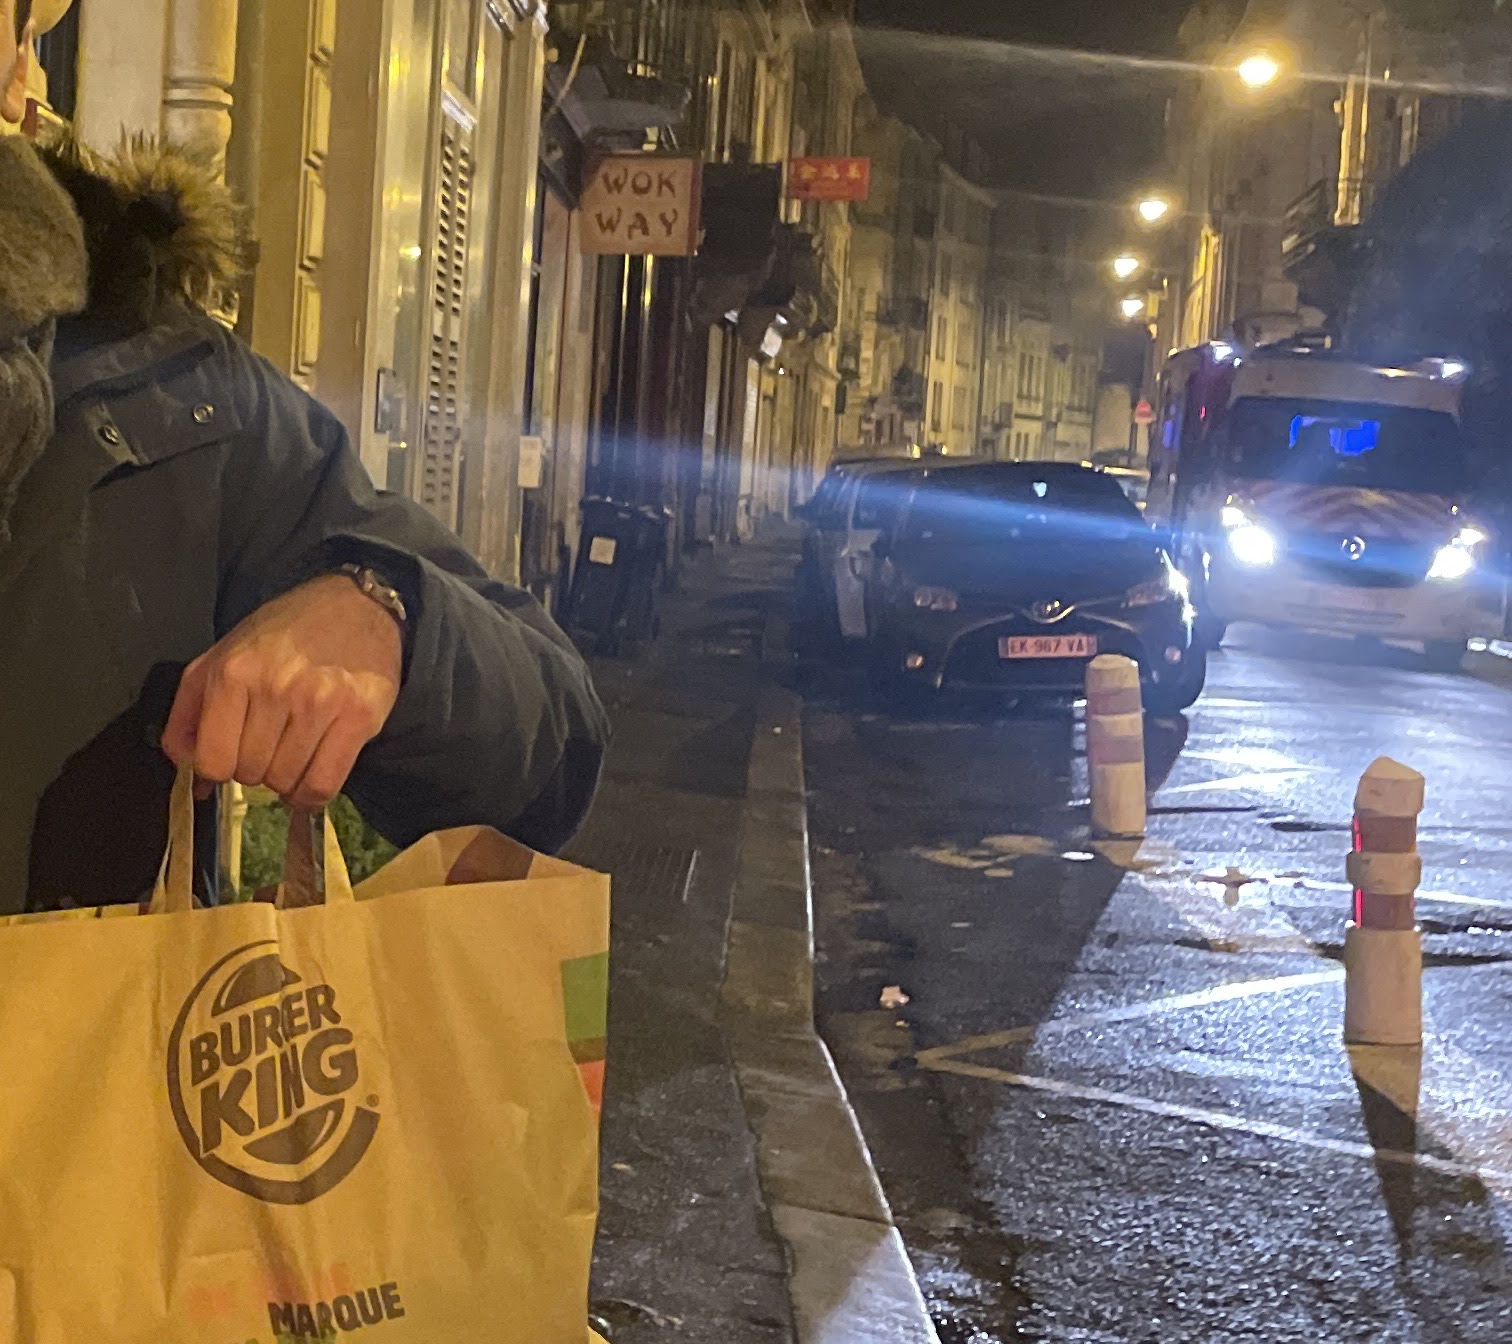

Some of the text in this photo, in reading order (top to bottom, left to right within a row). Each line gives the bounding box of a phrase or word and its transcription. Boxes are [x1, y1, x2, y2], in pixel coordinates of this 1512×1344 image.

[601, 167, 676, 198] WOK
[595, 207, 679, 240] WAY
[200, 1027, 359, 1154] KING
[267, 1281, 405, 1339] MARQUE
